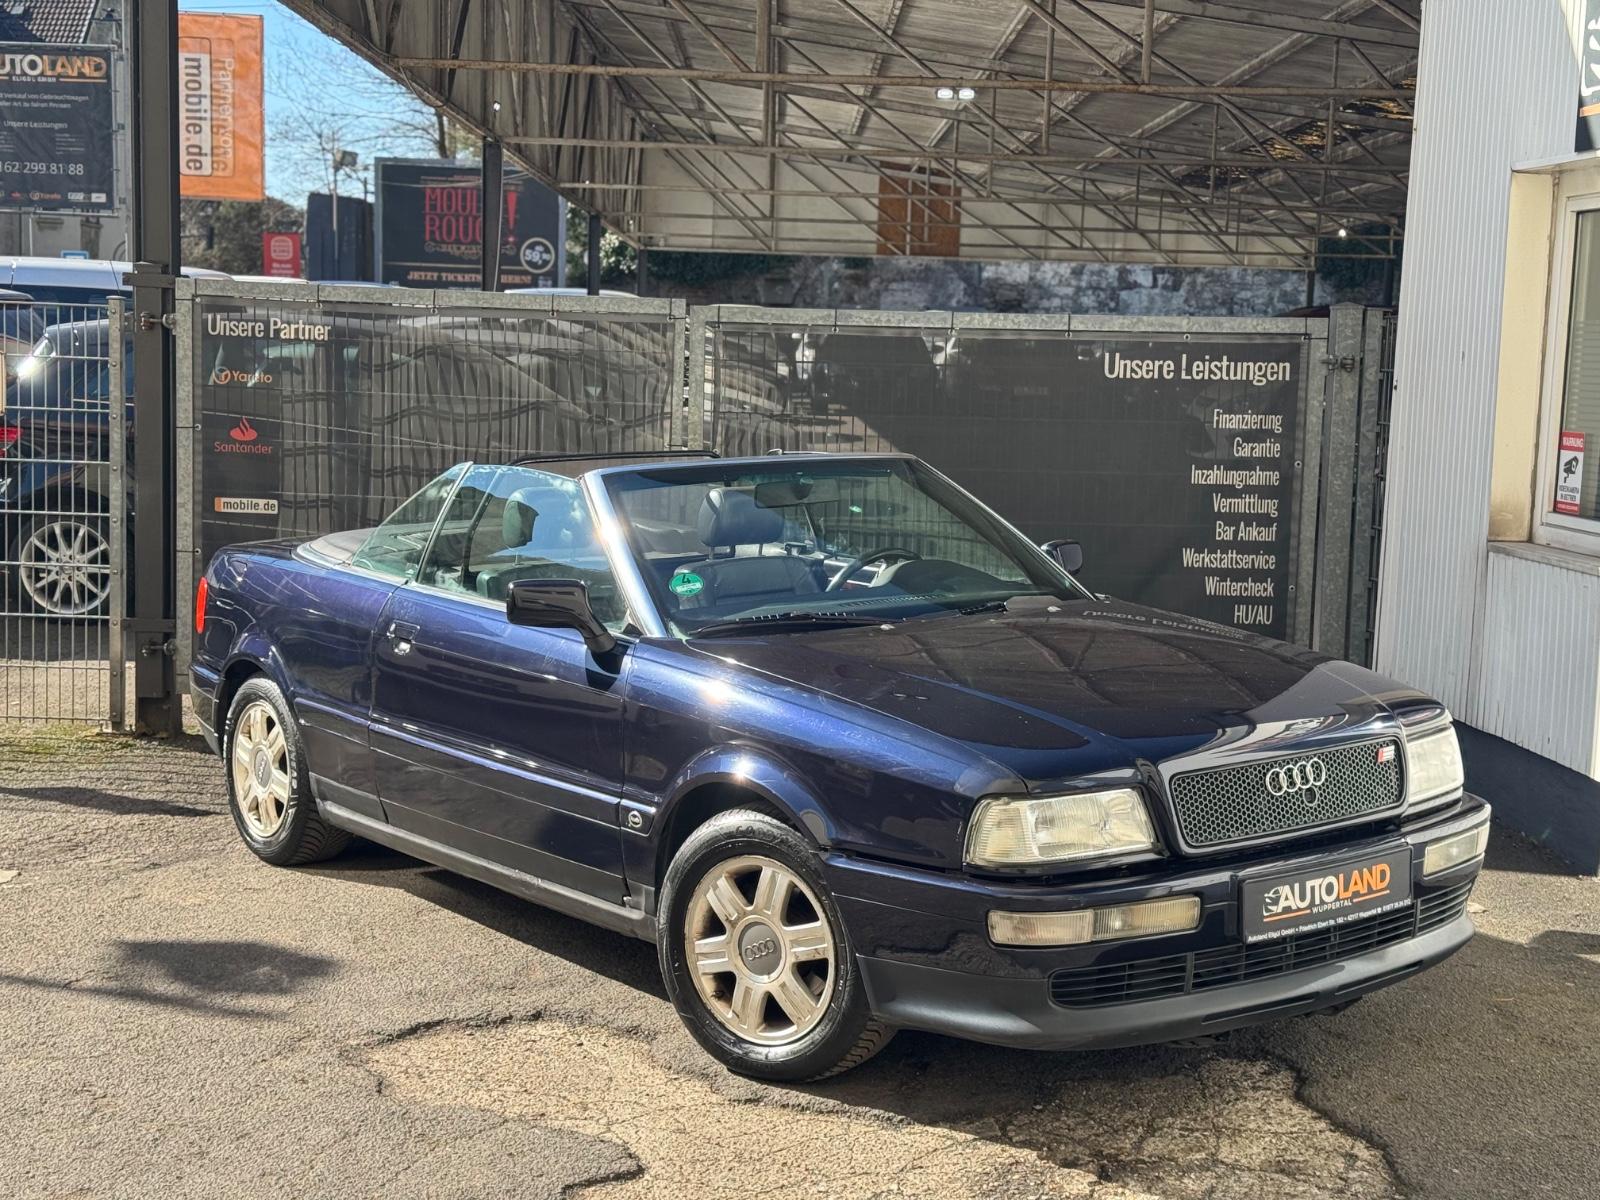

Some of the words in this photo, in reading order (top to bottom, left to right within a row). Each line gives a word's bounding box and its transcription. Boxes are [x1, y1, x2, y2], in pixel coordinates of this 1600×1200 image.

[184, 57, 207, 171] mobile.de
[23, 162, 46, 174] 299
[68, 163, 84, 175] 88
[424, 187, 481, 214] MOUL
[424, 215, 481, 243] ROU
[207, 314, 264, 338] Unsere
[269, 317, 332, 341] Partner
[1104, 352, 1174, 379] Unsere
[1181, 353, 1290, 386] Leistungen
[1213, 408, 1283, 433] Finanzierung
[214, 441, 273, 455] Santander
[1233, 437, 1281, 458] Garantie
[1191, 464, 1280, 489] Inzahlungnahme
[223, 499, 276, 512] mobile.de
[1212, 493, 1279, 518] Vermittlung
[1215, 520, 1236, 540] Bar
[1237, 521, 1277, 542] Ankauf
[1182, 547, 1276, 570] Werkstattservice
[1205, 575, 1274, 598] Wintercheck
[1233, 604, 1273, 625] HU/AU
[1276, 863, 1391, 914] AUTOLAND
[1311, 898, 1353, 914] WUPPERTAL
